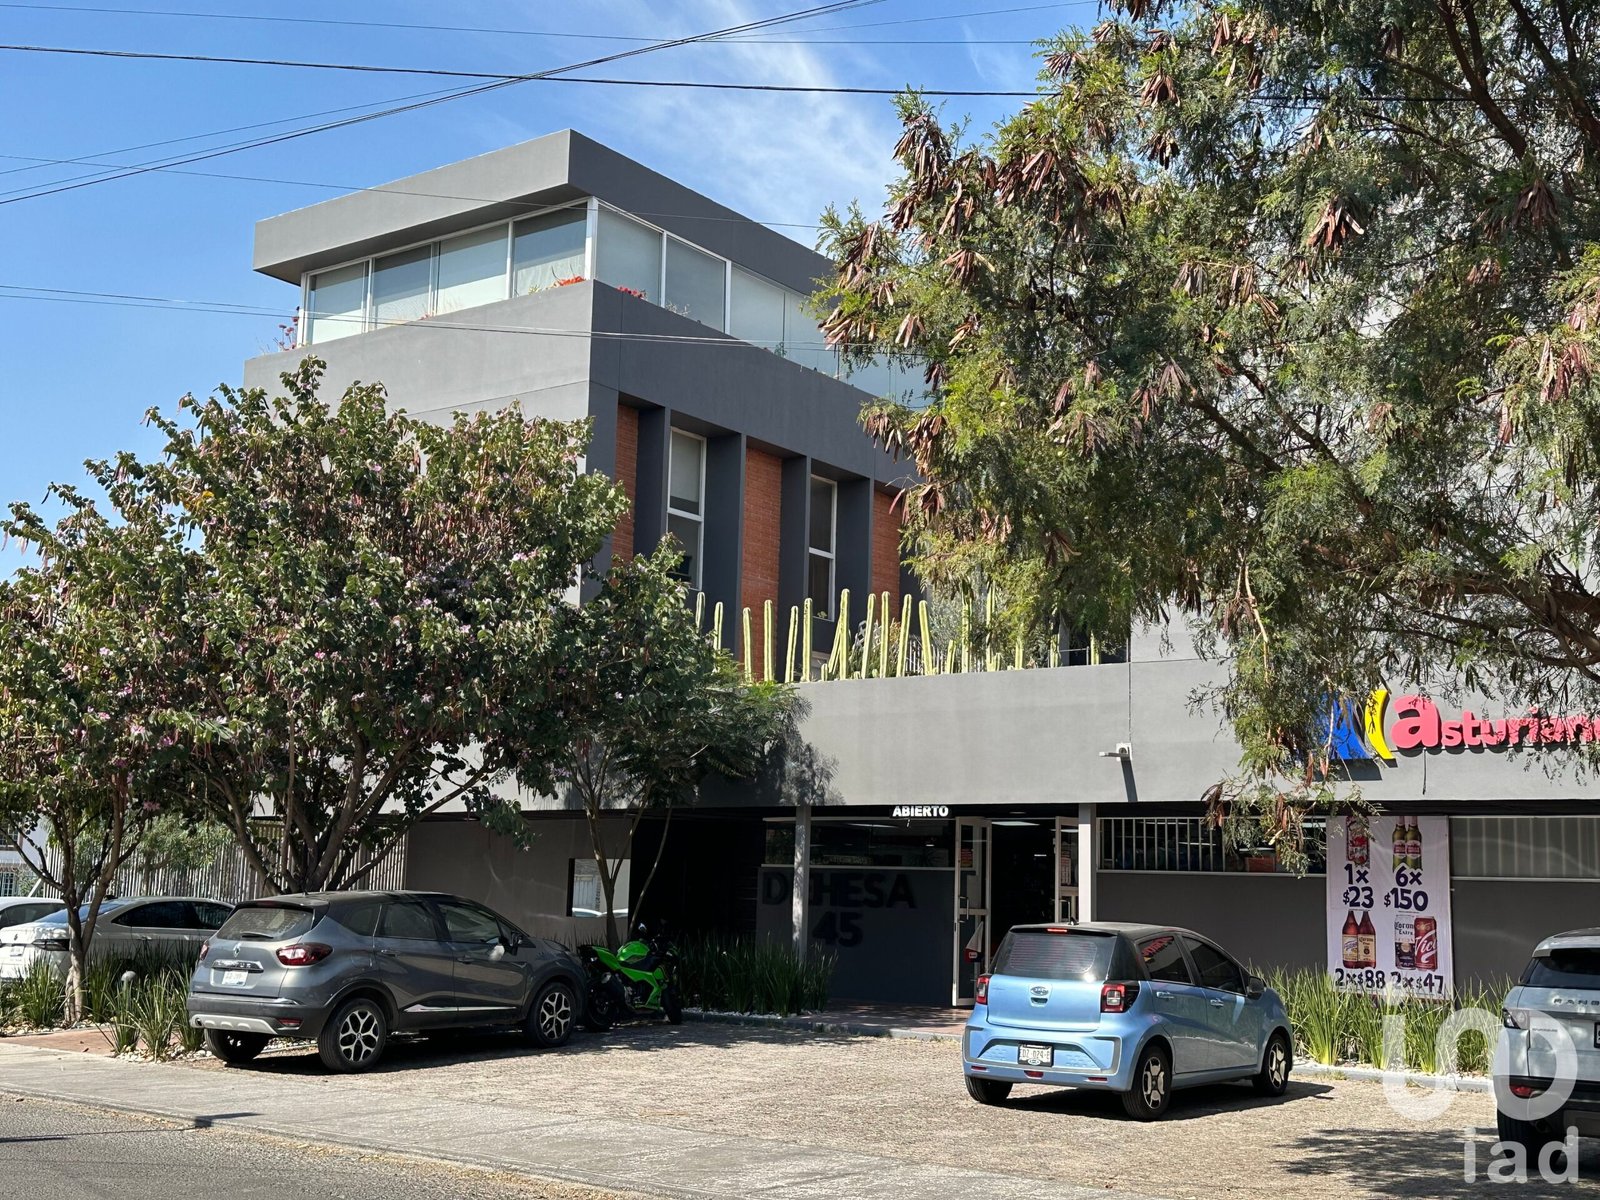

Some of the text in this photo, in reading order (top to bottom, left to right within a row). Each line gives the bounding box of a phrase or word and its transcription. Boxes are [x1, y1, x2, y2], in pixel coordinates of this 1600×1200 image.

[1390, 694, 1600, 749] asturian
[892, 805, 949, 817] ABIERTO
[1344, 863, 1369, 885] 1x
[1395, 865, 1423, 887] 6x
[762, 871, 918, 909] DHESA
[1343, 886, 1374, 908] $23
[1383, 887, 1429, 912] $150
[812, 911, 864, 947] 45
